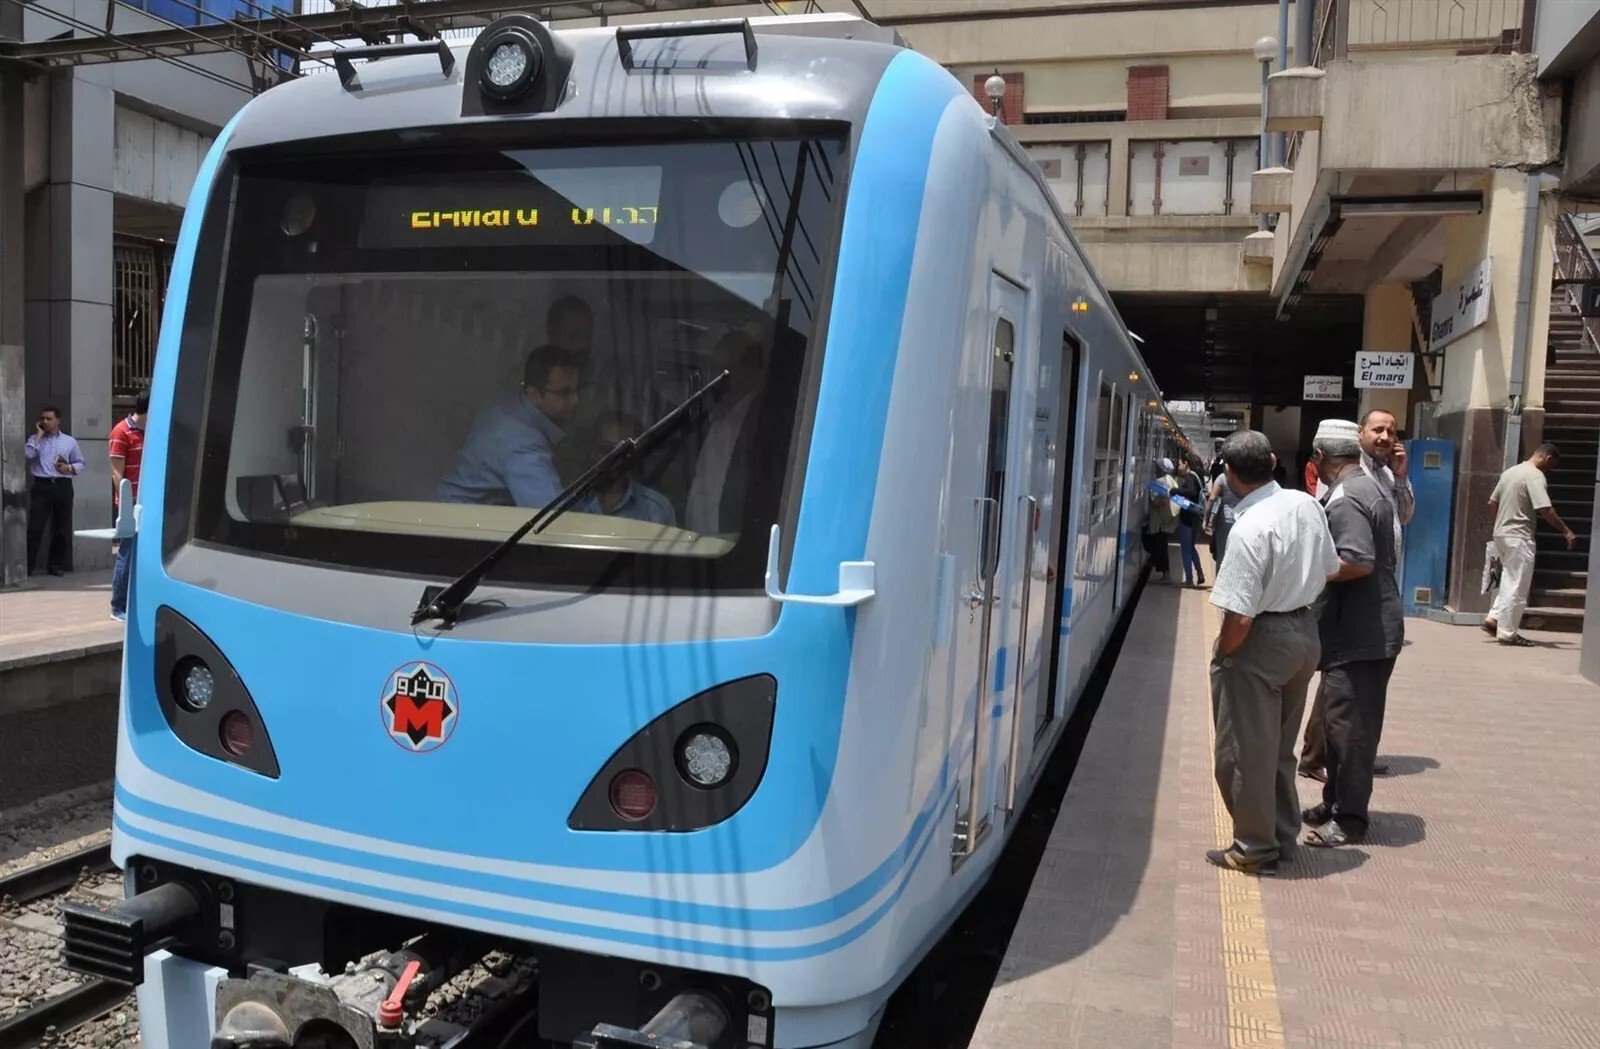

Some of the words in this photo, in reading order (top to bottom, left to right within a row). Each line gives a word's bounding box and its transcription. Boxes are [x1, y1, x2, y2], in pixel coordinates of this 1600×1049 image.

[1361, 371, 1373, 381] El
[1375, 373, 1405, 384] marg
[393, 694, 445, 738] M
